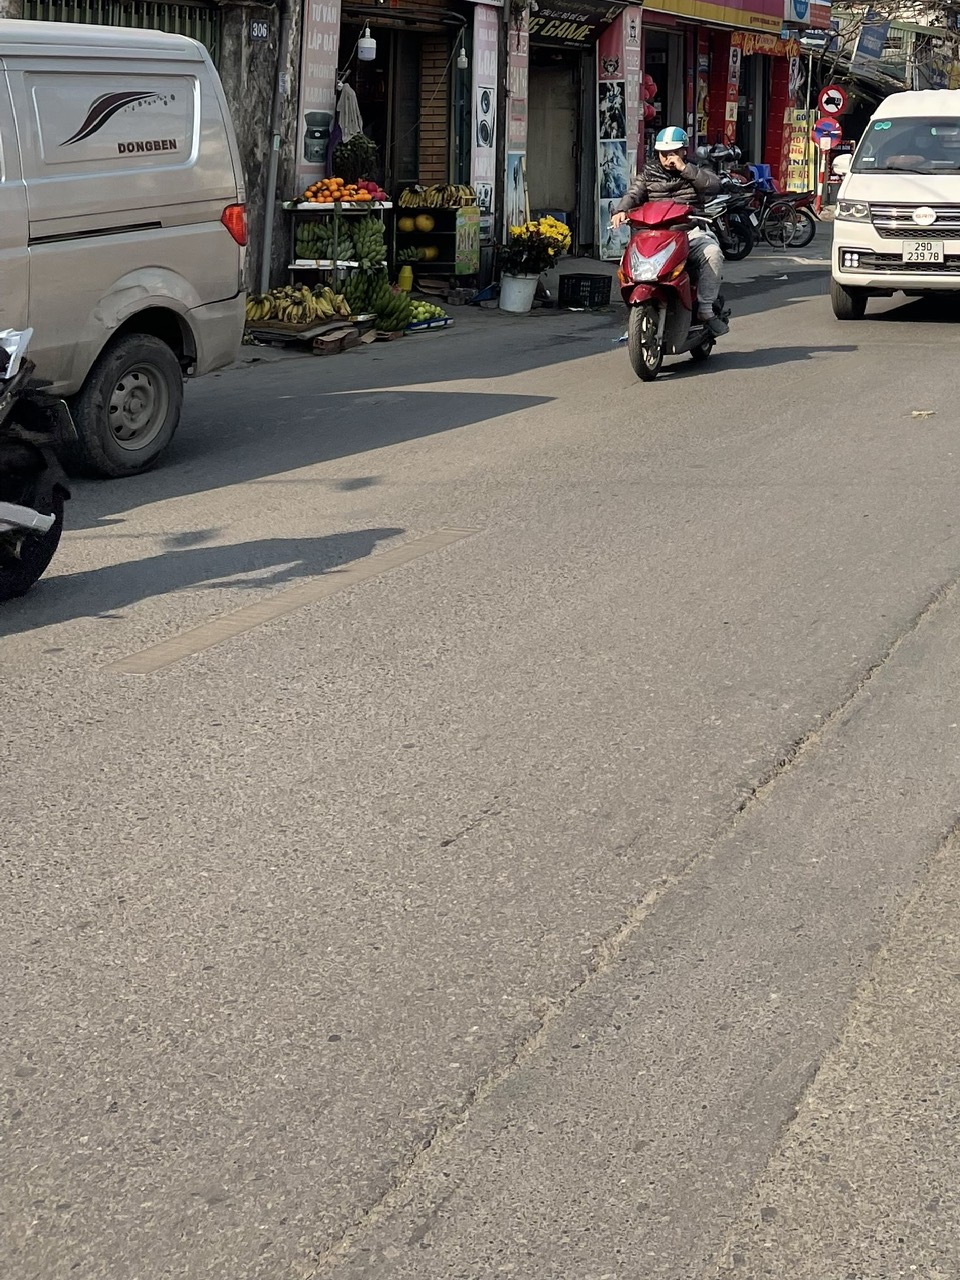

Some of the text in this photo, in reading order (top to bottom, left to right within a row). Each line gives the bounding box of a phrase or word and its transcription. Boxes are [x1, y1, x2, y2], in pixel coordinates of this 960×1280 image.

[252, 22, 267, 38] 306
[540, 19, 596, 41] GAME
[118, 138, 178, 154] DONGBEN
[914, 242, 933, 252] 29D
[907, 253, 940, 262] 239.78
